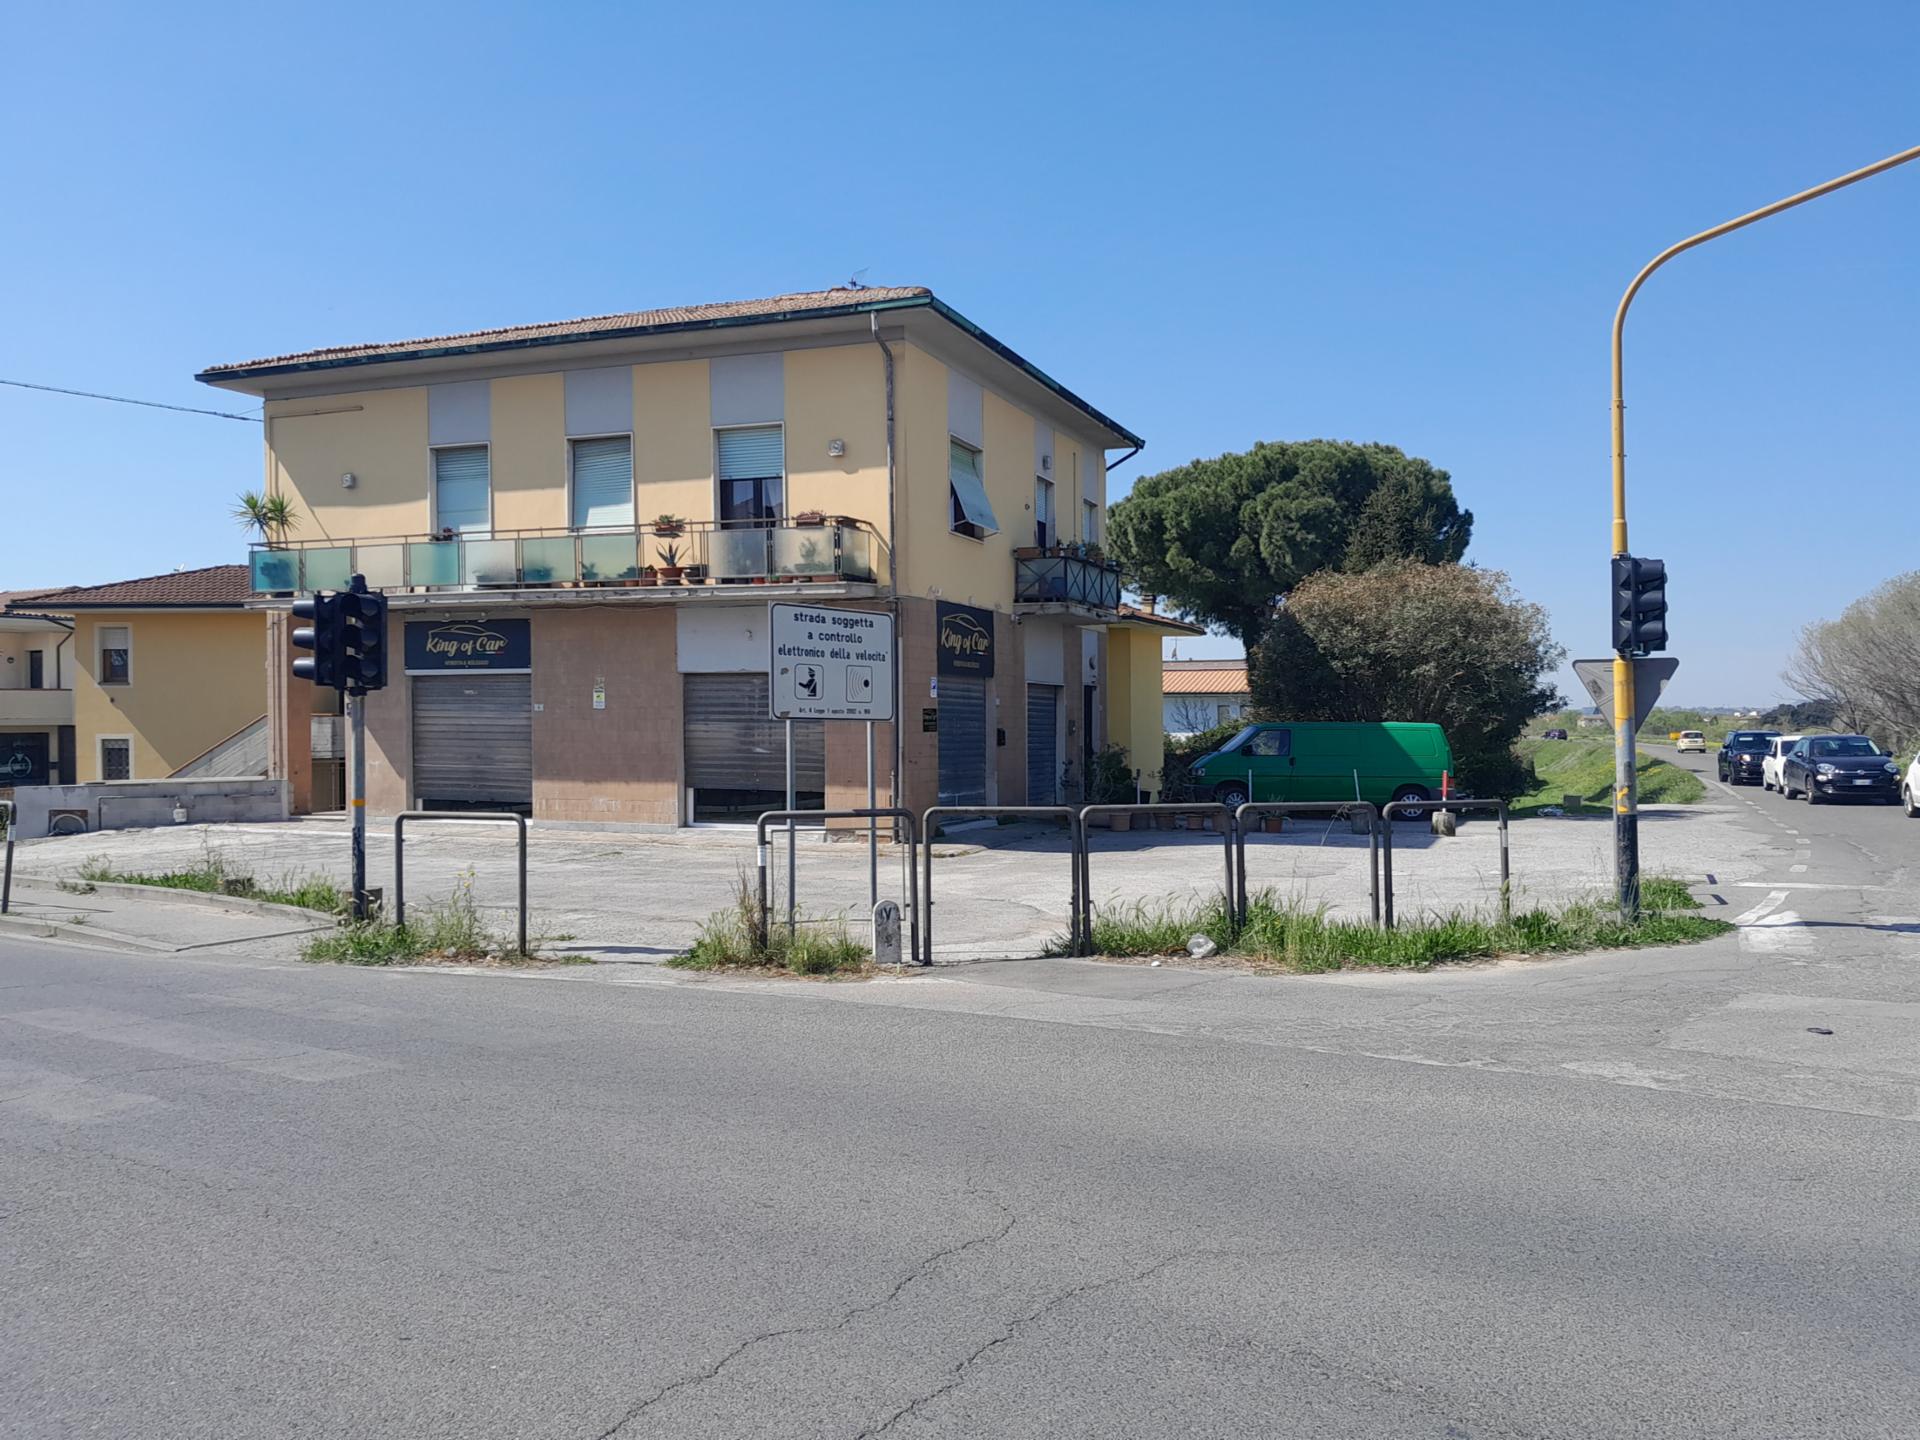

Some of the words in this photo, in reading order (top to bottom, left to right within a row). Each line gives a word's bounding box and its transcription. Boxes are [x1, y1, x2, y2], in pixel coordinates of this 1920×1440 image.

[793, 612, 826, 624] strada
[832, 616, 874, 629] soggetta
[426, 637, 459, 657] King
[461, 640, 473, 655] of
[476, 636, 507, 651] Car
[807, 632, 813, 640] a
[818, 632, 863, 644] controllo
[941, 627, 962, 655] King
[963, 635, 971, 655] of
[972, 633, 989, 651] Car
[778, 644, 825, 658] elettronico
[830, 648, 851, 660] della
